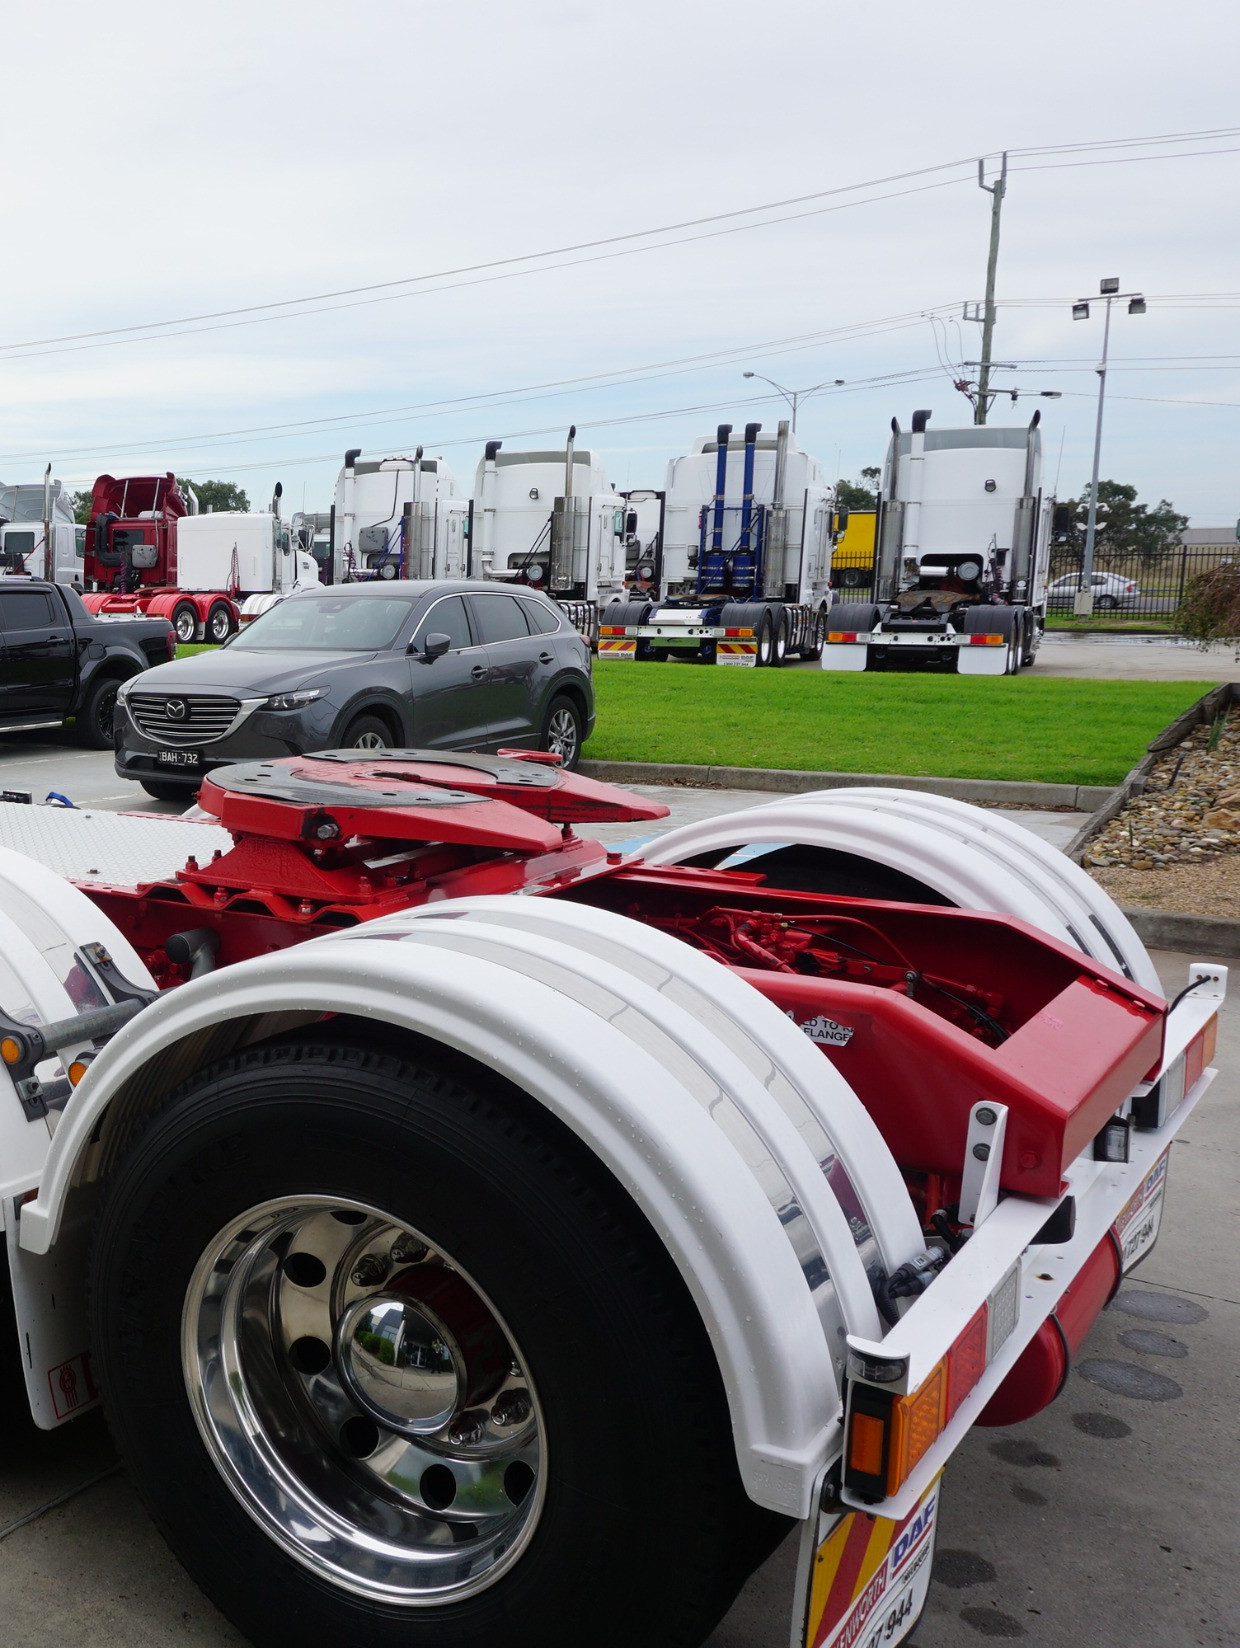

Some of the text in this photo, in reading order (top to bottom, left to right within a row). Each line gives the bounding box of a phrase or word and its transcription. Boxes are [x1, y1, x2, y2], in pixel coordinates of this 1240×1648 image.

[822, 1020, 839, 1030] TO
[1145, 1160, 1165, 1193] DAF
[893, 1495, 936, 1567] DAF
[885, 1588, 913, 1640] 944
